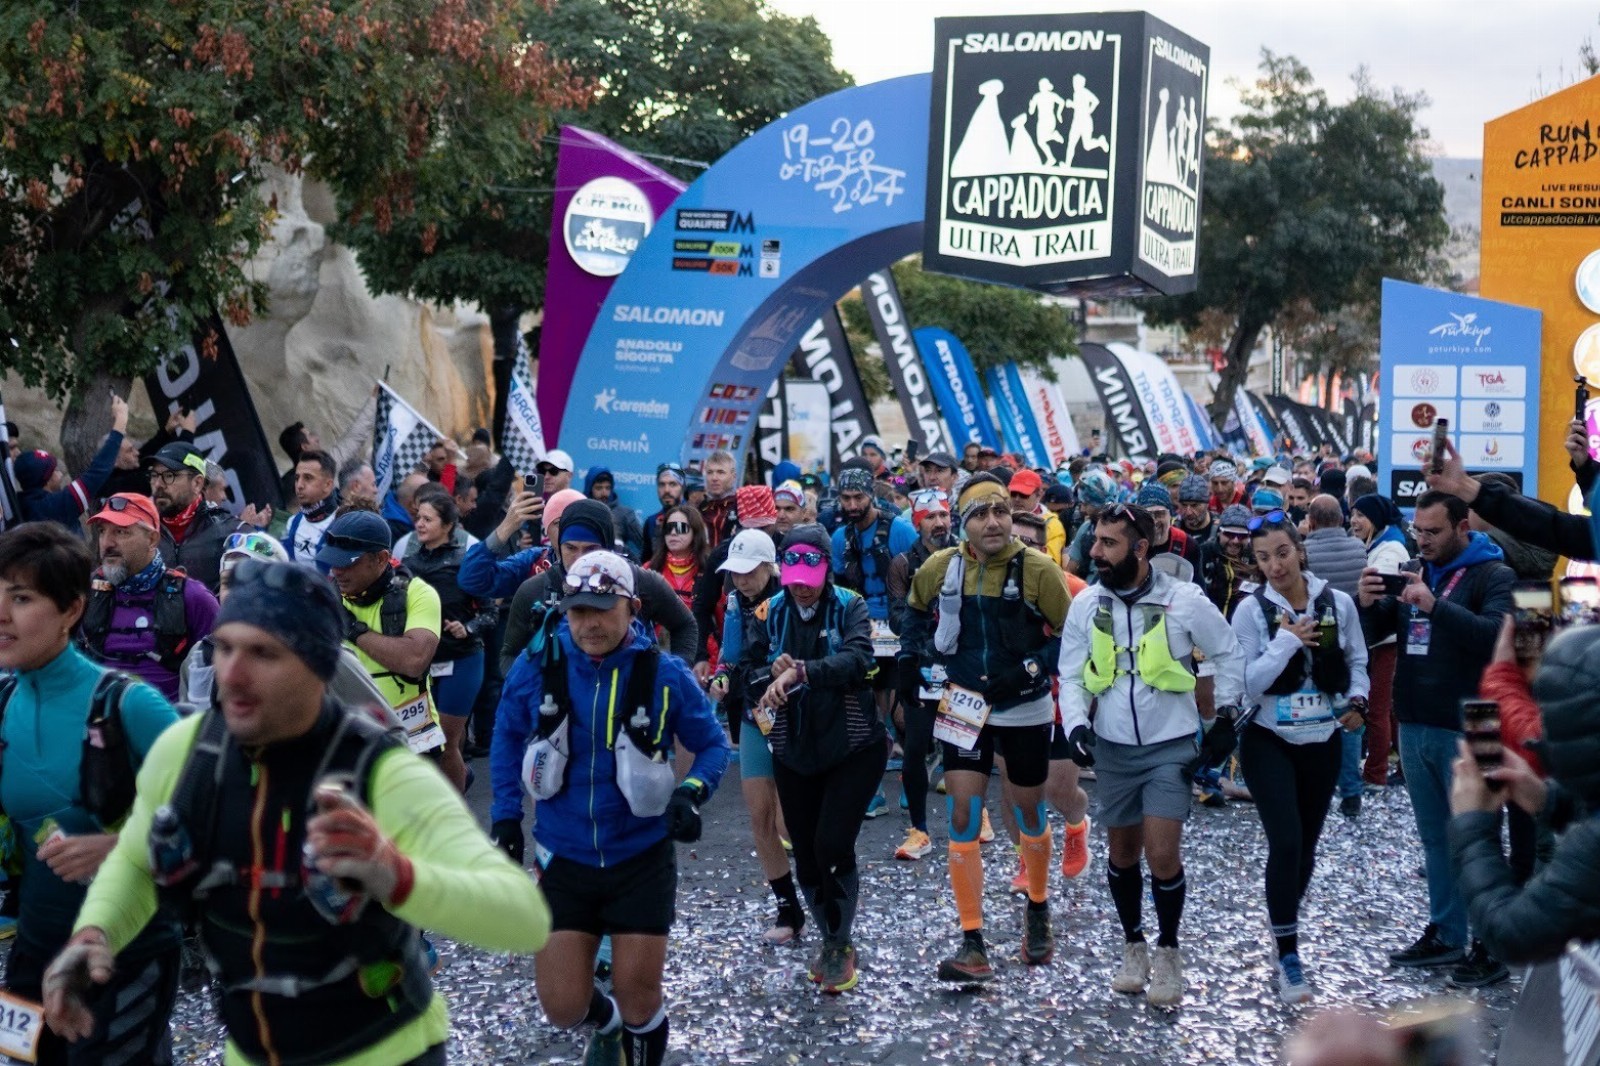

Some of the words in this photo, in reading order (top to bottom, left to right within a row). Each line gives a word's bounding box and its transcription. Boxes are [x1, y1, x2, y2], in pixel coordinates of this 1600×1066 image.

[963, 30, 1104, 53] SALOMON
[1154, 36, 1202, 77] SALOMON
[782, 117, 876, 159] 19-20
[1540, 118, 1591, 145] RUN
[1514, 141, 1599, 169] CAPPAD
[829, 175, 905, 214] 2024
[952, 175, 1103, 219] CAPPADOCIA
[1541, 183, 1566, 192] LIVE
[1569, 183, 1600, 192] RESU
[1145, 184, 1195, 233] CAPPADOCIA
[1501, 196, 1555, 208] CANLI
[1560, 196, 1600, 208] SON
[679, 219, 728, 230] QUALIFIER
[950, 226, 1021, 258] ULTRA
[1032, 228, 1100, 257] TRAIL
[1144, 231, 1170, 270] ULTRA
[1171, 245, 1192, 270] TRAIL
[613, 304, 725, 327] SALOMON
[616, 338, 683, 353] ANADOLU
[612, 398, 670, 415] corendon
[587, 437, 649, 453] GARMIN
[1397, 480, 1429, 497] SA
[397, 702, 425, 721] 295
[953, 691, 983, 711] 1210
